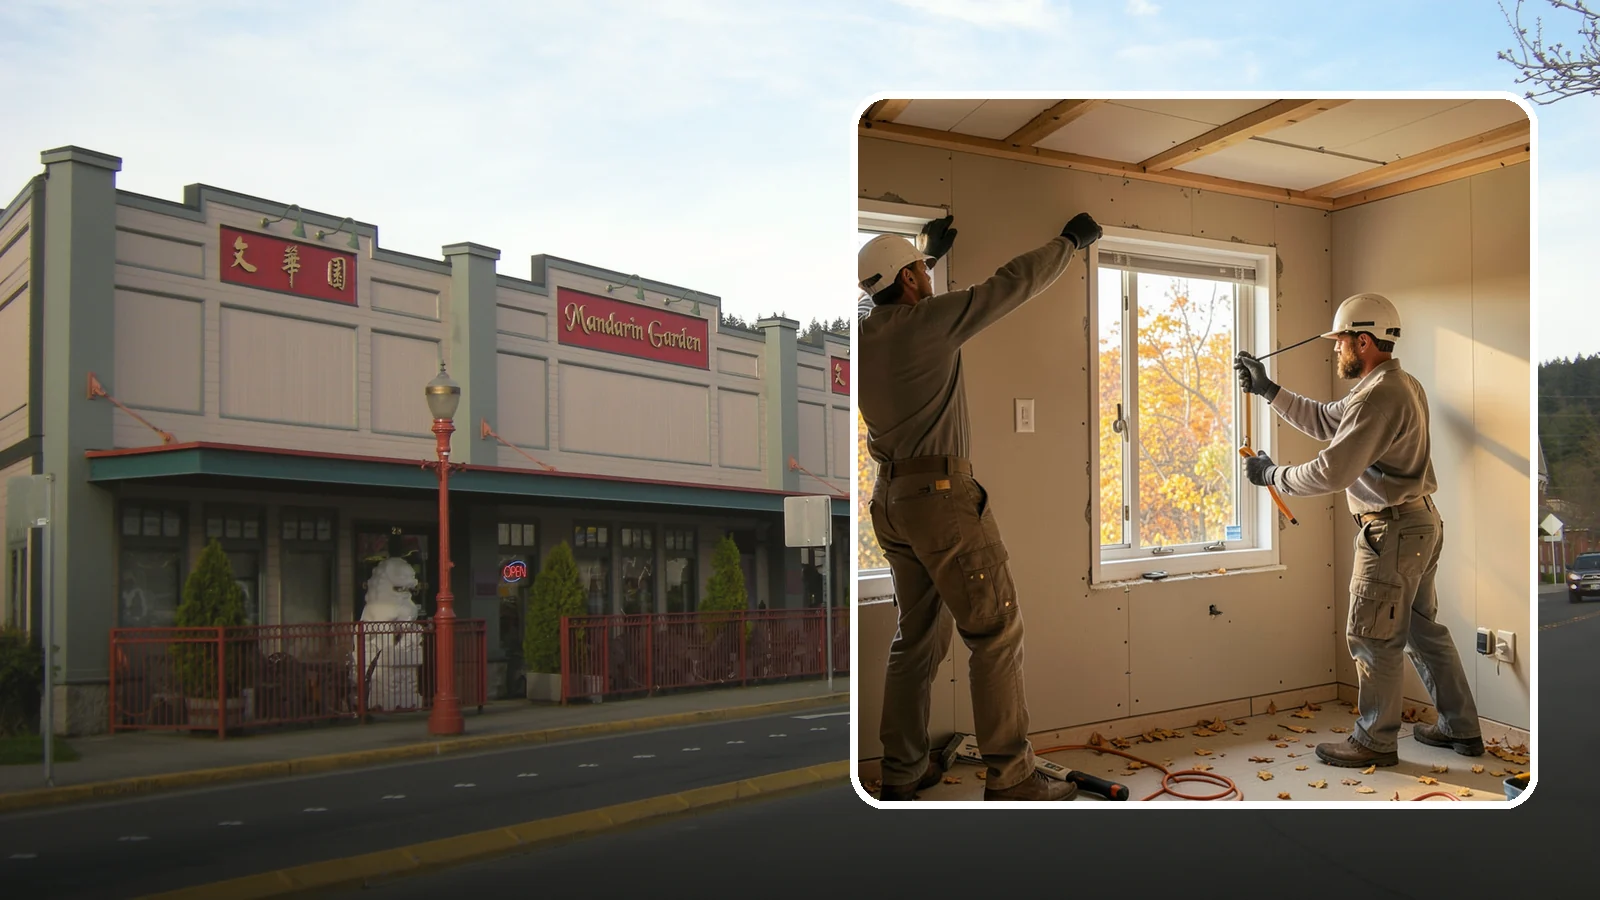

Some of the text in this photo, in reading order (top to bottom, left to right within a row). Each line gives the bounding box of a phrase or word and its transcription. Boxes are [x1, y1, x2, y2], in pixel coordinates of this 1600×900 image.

[231, 236, 346, 290] 文華園
[565, 302, 701, 352] Mandarin Garden
[503, 565, 527, 578] OPEN
